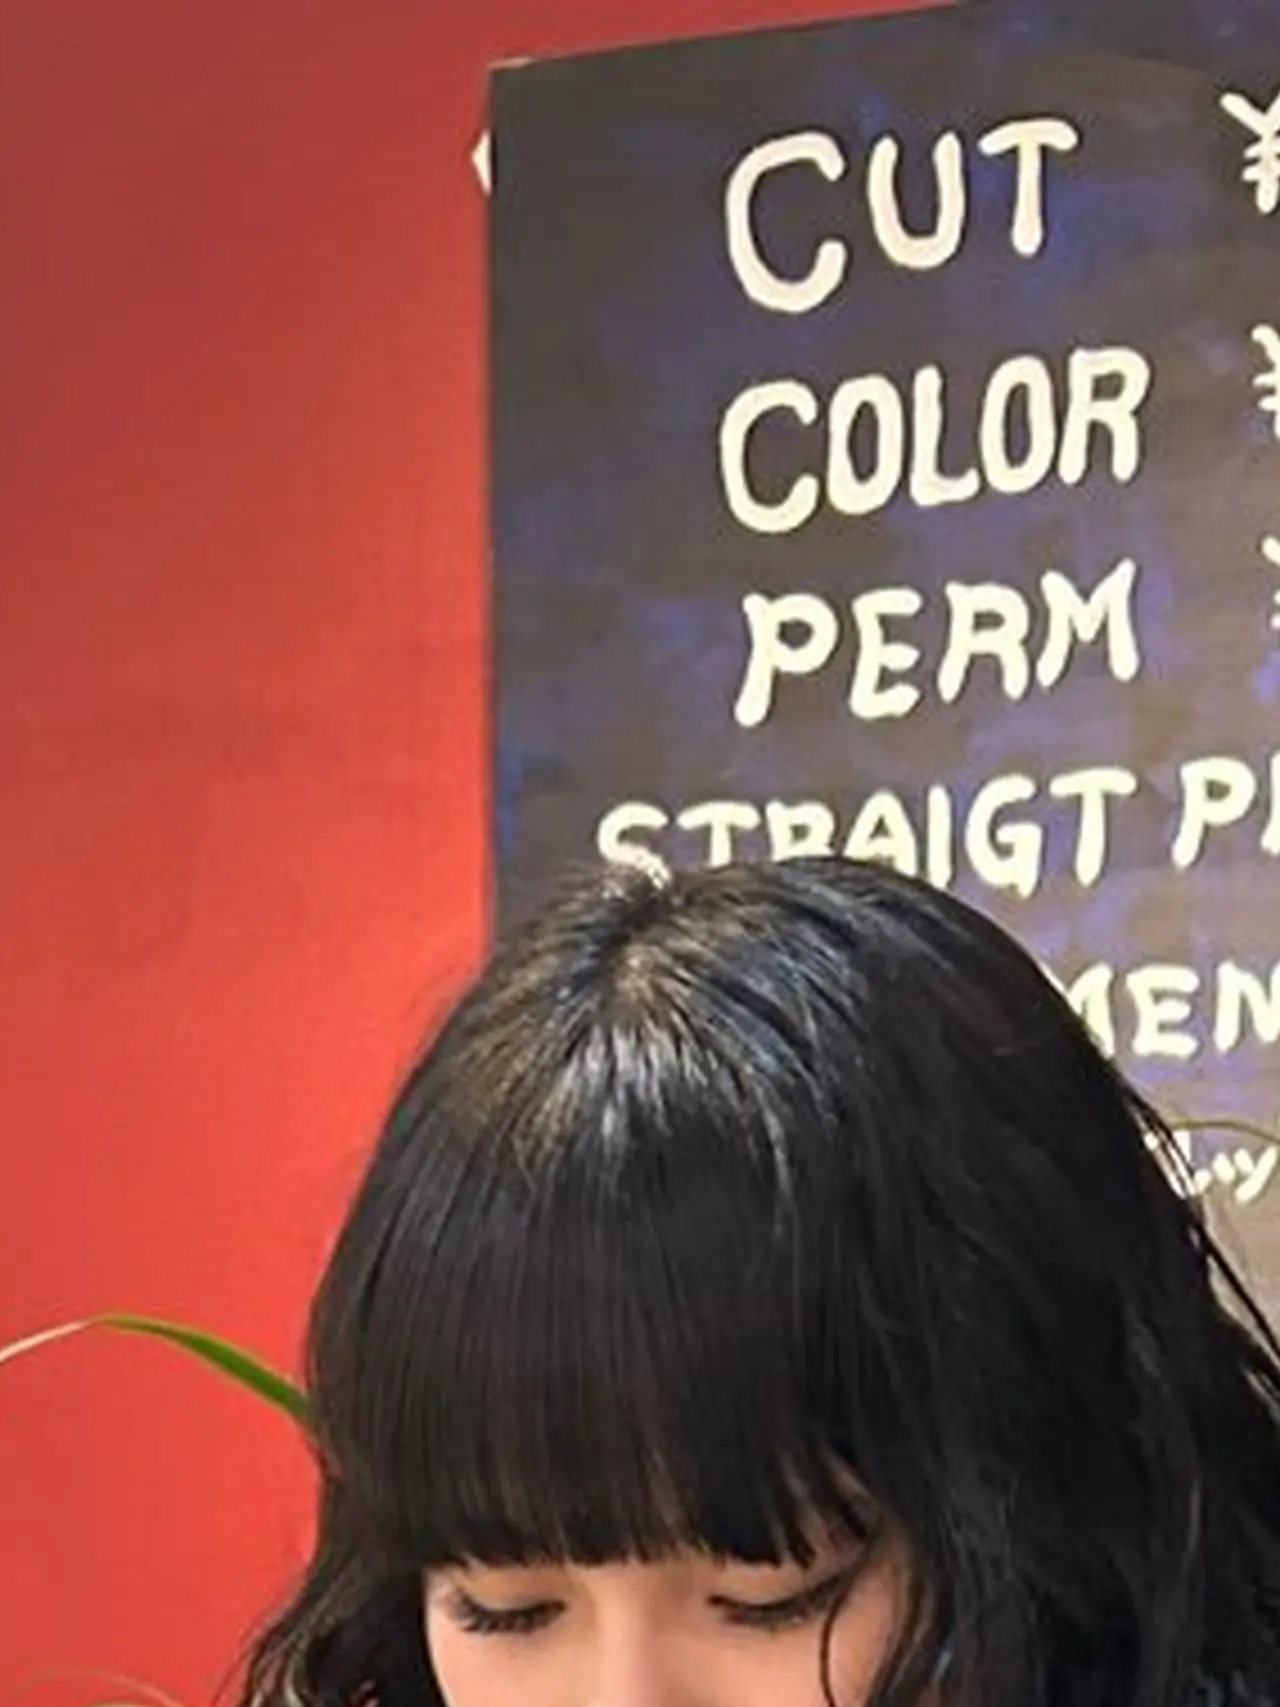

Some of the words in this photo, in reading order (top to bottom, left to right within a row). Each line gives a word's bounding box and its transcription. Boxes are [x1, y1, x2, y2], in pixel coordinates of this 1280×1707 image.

[725, 119, 1078, 313] CUT
[720, 347, 1150, 532] COLOR
[734, 558, 1140, 728] PERM
